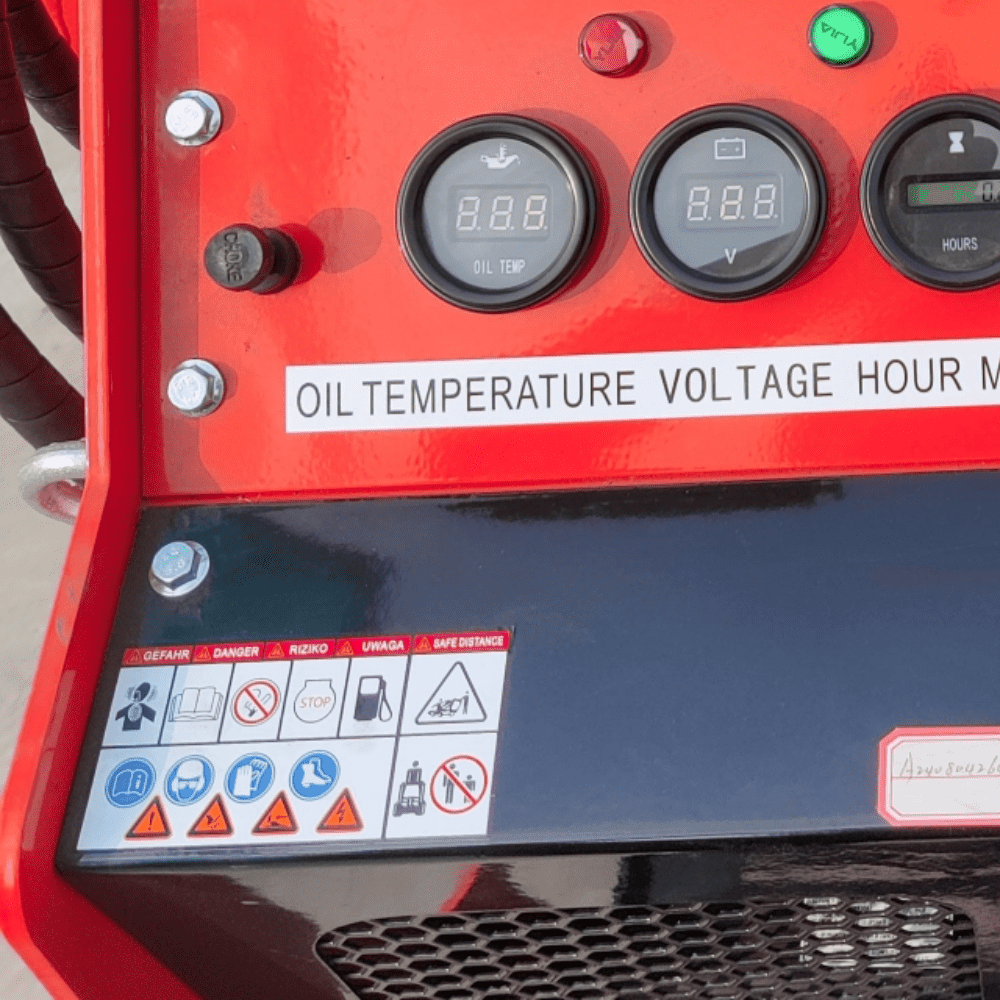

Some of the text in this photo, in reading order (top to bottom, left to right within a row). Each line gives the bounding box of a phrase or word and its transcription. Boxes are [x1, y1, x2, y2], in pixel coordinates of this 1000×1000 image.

[942, 237, 978, 251] HOURS
[224, 232, 243, 283] CHOKE
[724, 248, 736, 264] V
[473, 259, 526, 274] OIL TEMP
[296, 382, 353, 417] OIL
[362, 370, 636, 415] TEMPERATURE
[659, 362, 833, 404] VOLTAGE
[857, 357, 962, 395] HOUR
[362, 640, 405, 652] UWAGA
[433, 635, 504, 649] SAFE DISTANCE
[143, 649, 190, 661] GEFAHR
[213, 646, 260, 658] DANGER
[288, 643, 329, 656] RIZIKO
[299, 697, 331, 708] STOP
